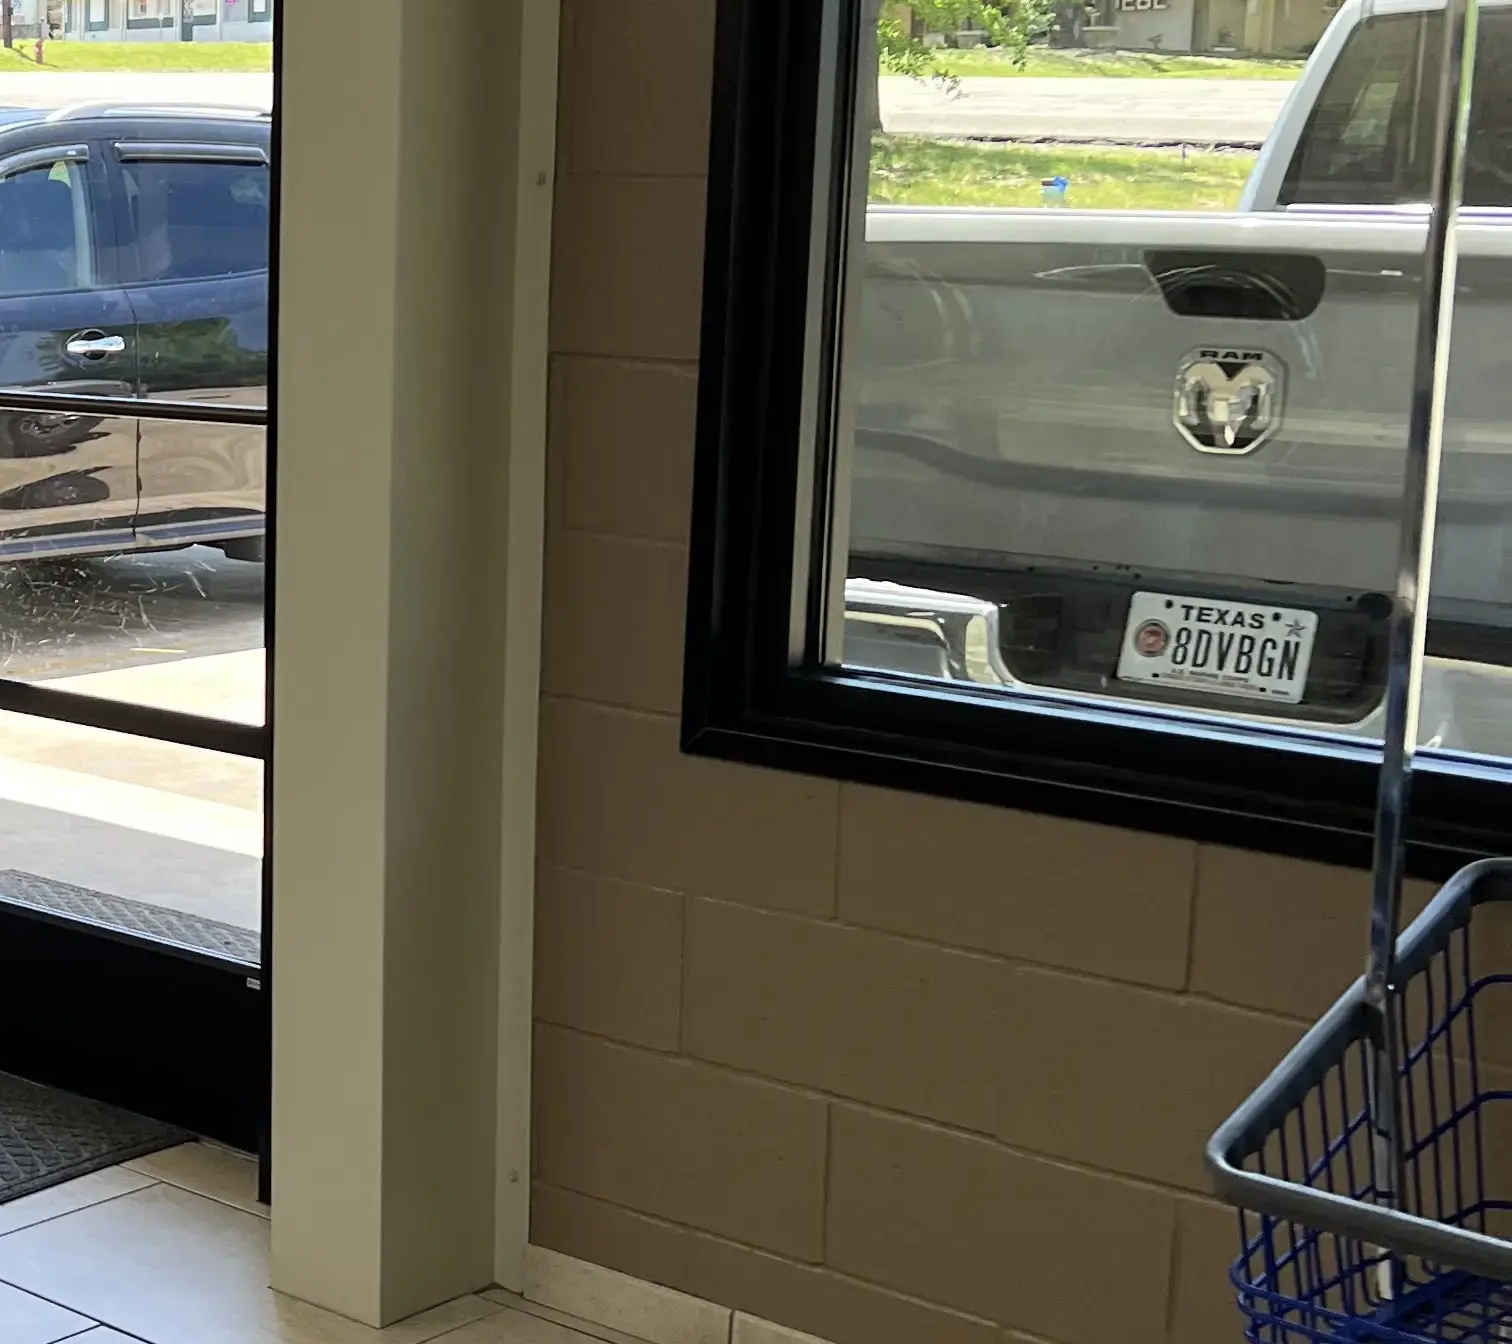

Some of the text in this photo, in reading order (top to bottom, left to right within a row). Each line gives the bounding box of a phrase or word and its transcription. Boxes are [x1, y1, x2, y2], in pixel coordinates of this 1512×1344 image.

[1200, 350, 1263, 360] RAM
[1181, 604, 1265, 629] TEXAS
[1171, 627, 1301, 681] 8DVBGN
